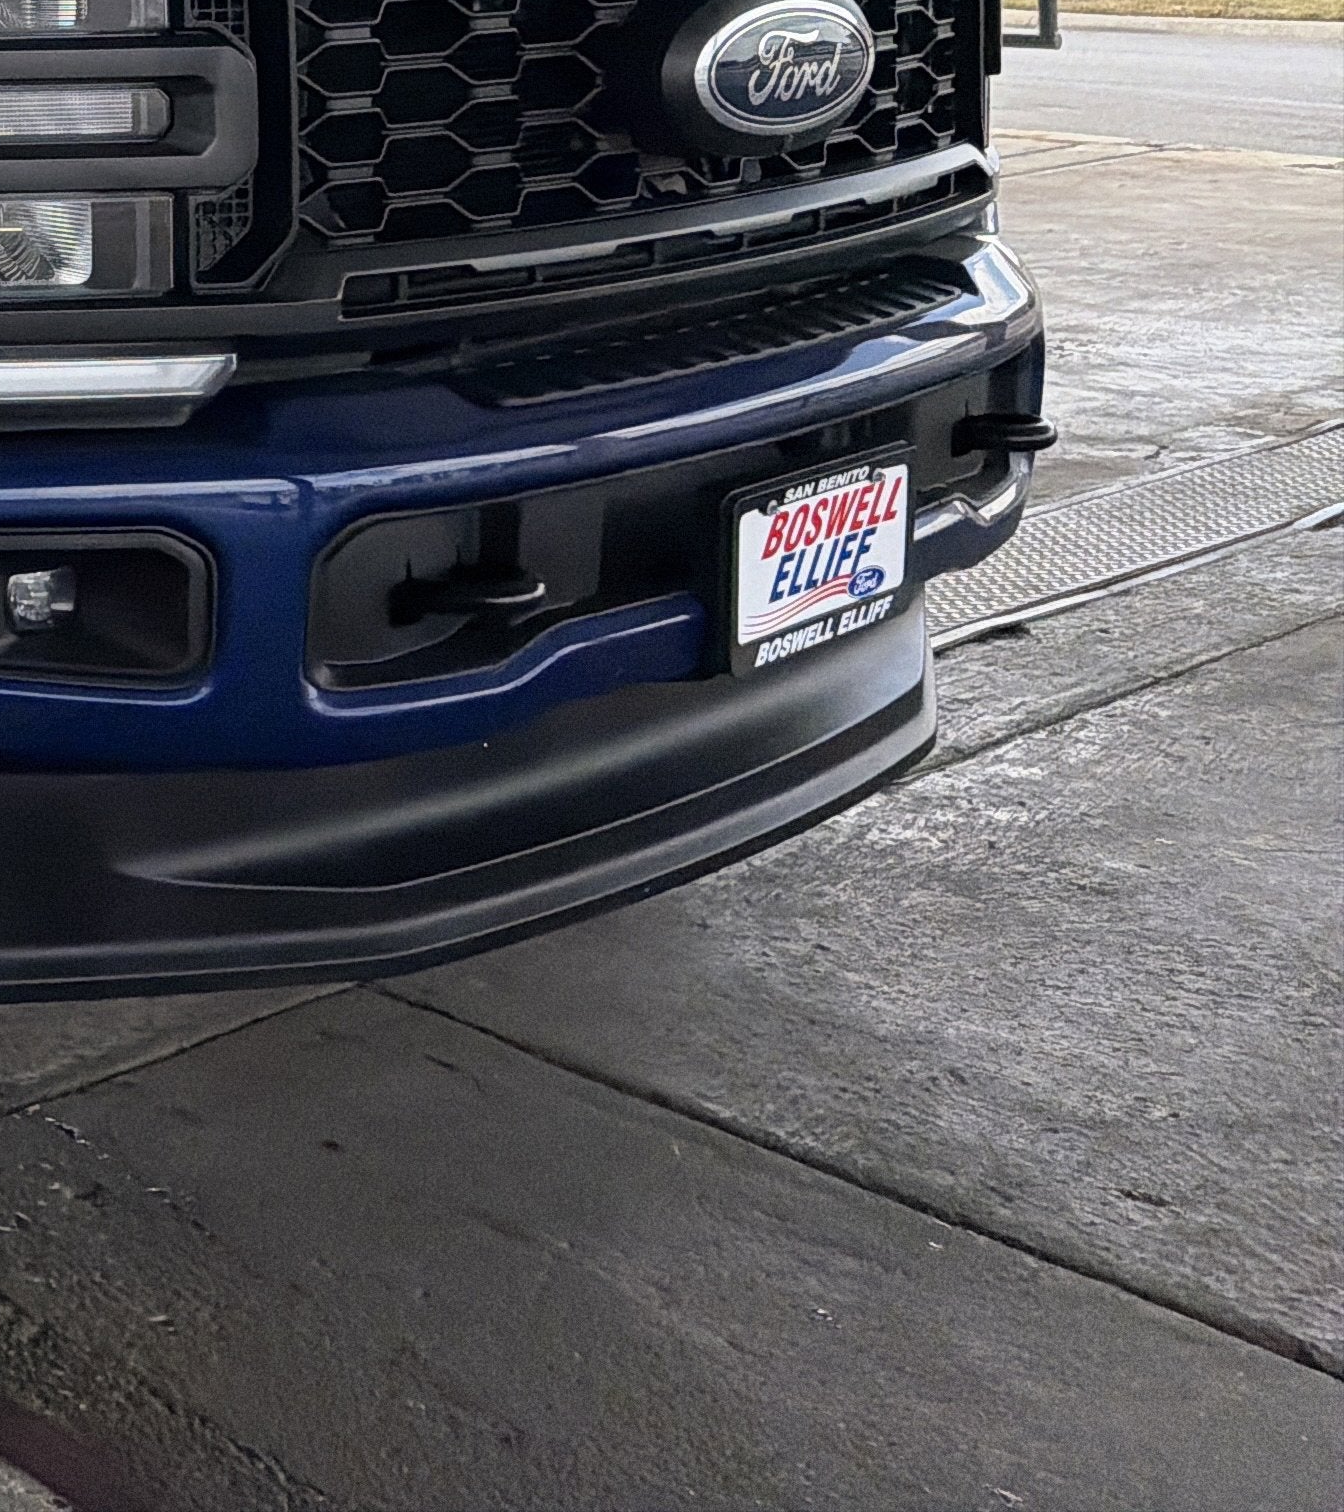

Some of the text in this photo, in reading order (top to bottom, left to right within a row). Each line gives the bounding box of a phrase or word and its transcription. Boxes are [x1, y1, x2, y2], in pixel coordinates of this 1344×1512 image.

[747, 29, 851, 106] Ford
[761, 476, 903, 560] BOSWELL
[784, 465, 870, 503] SAN BENITO
[768, 527, 878, 603] ELLIFF
[852, 570, 881, 595] Ford
[754, 594, 895, 668] BOSWELL ELLIFF
